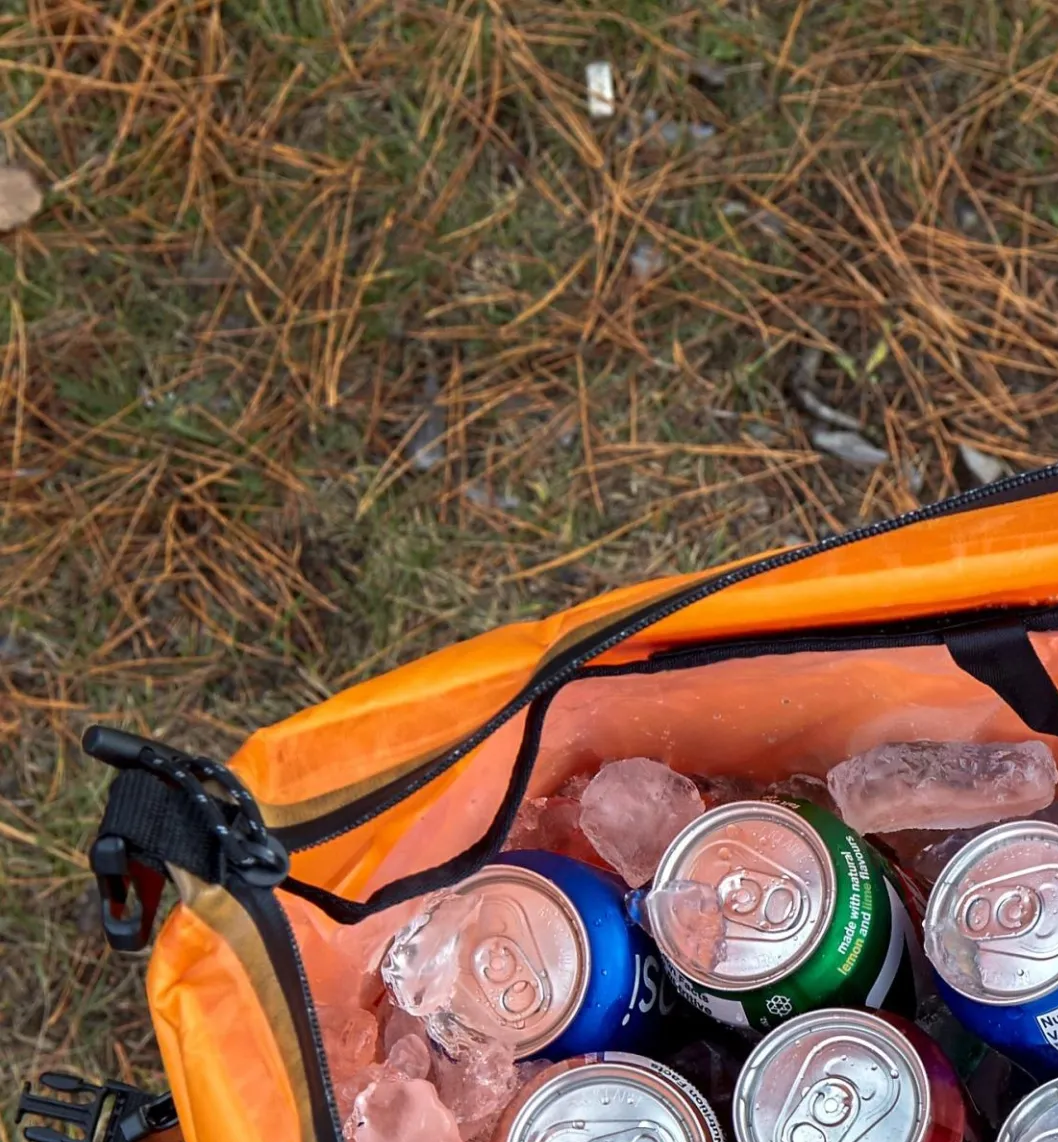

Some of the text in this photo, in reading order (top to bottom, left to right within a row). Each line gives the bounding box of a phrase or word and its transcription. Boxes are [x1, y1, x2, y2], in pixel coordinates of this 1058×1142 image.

[837, 835, 873, 976] lemon and lime flavours
[838, 851, 861, 954] made with natural
[651, 1062, 687, 1089] Facts
